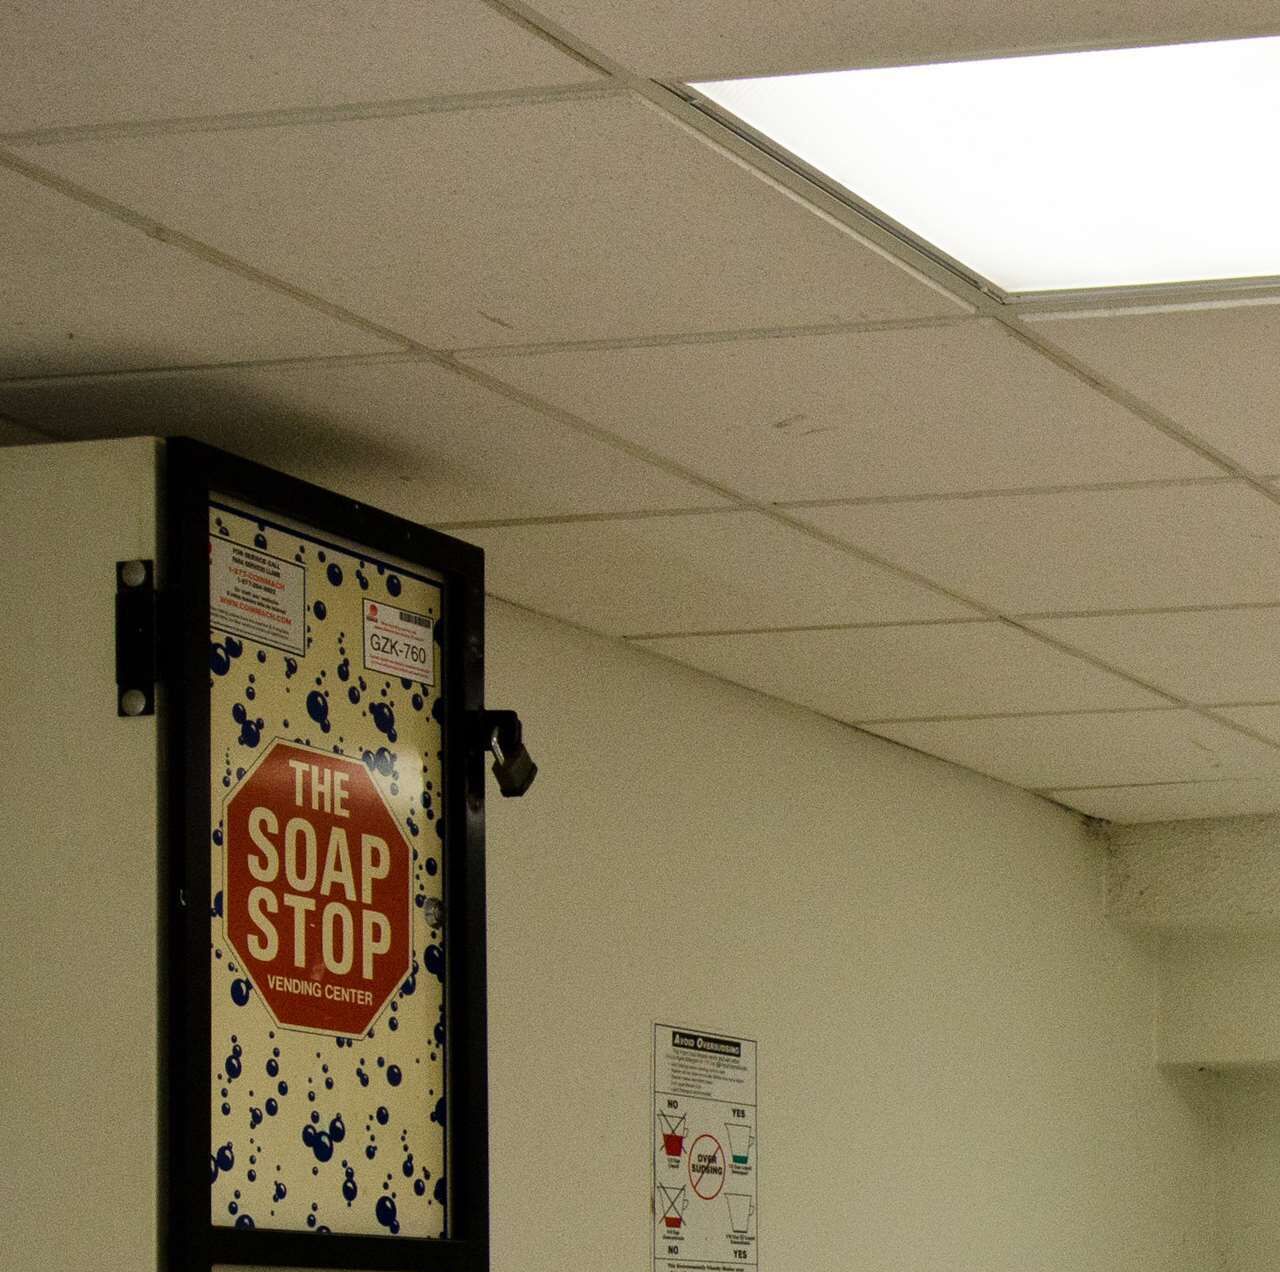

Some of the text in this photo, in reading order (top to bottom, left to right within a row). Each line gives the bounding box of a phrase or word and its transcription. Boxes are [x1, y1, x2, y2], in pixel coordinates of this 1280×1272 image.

[370, 634, 426, 664] GZK-760
[288, 759, 351, 818] THE
[247, 806, 391, 904] SOAP
[247, 886, 392, 980] STOP
[267, 974, 374, 1006] VENDING CENTER
[667, 1099, 679, 1109] NO
[732, 1109, 746, 1118] YES
[668, 1245, 679, 1255] NO
[733, 1249, 747, 1259] YES
